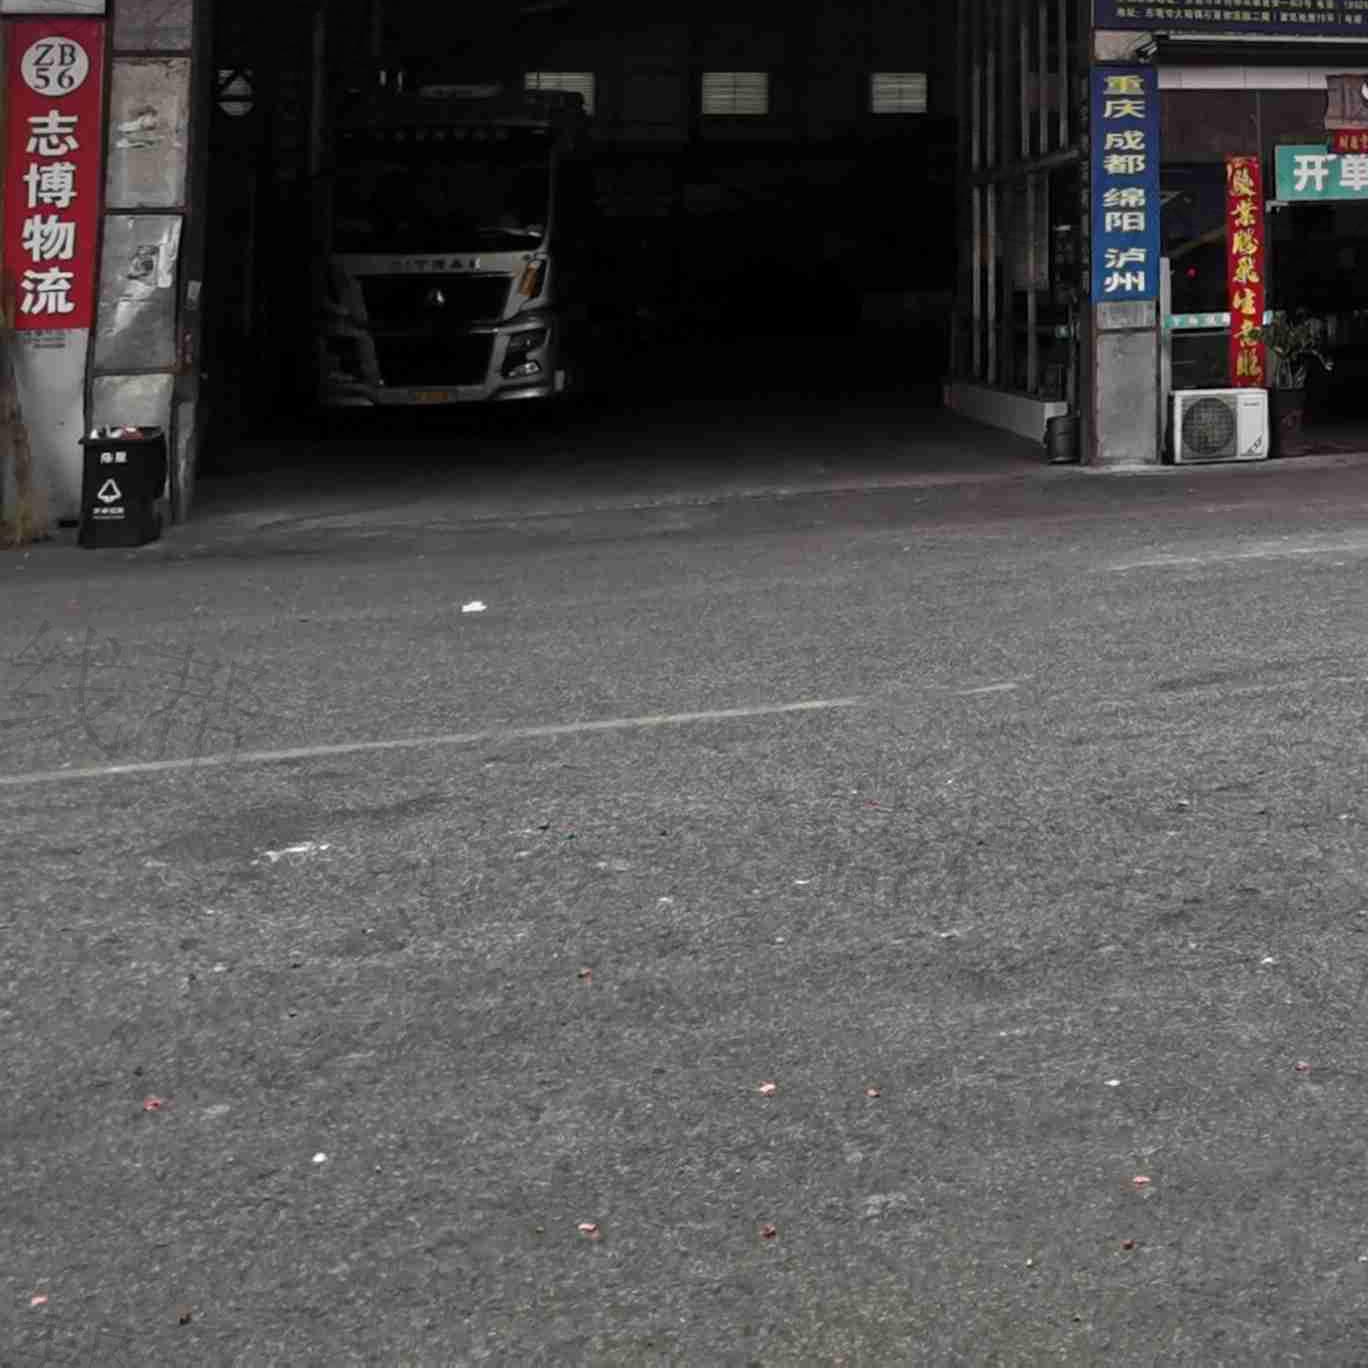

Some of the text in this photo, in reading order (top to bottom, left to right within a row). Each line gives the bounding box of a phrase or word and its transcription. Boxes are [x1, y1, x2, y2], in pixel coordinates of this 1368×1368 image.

[32, 43, 76, 66] ZB
[34, 67, 75, 89] 56
[21, 109, 78, 314] 志博物流
